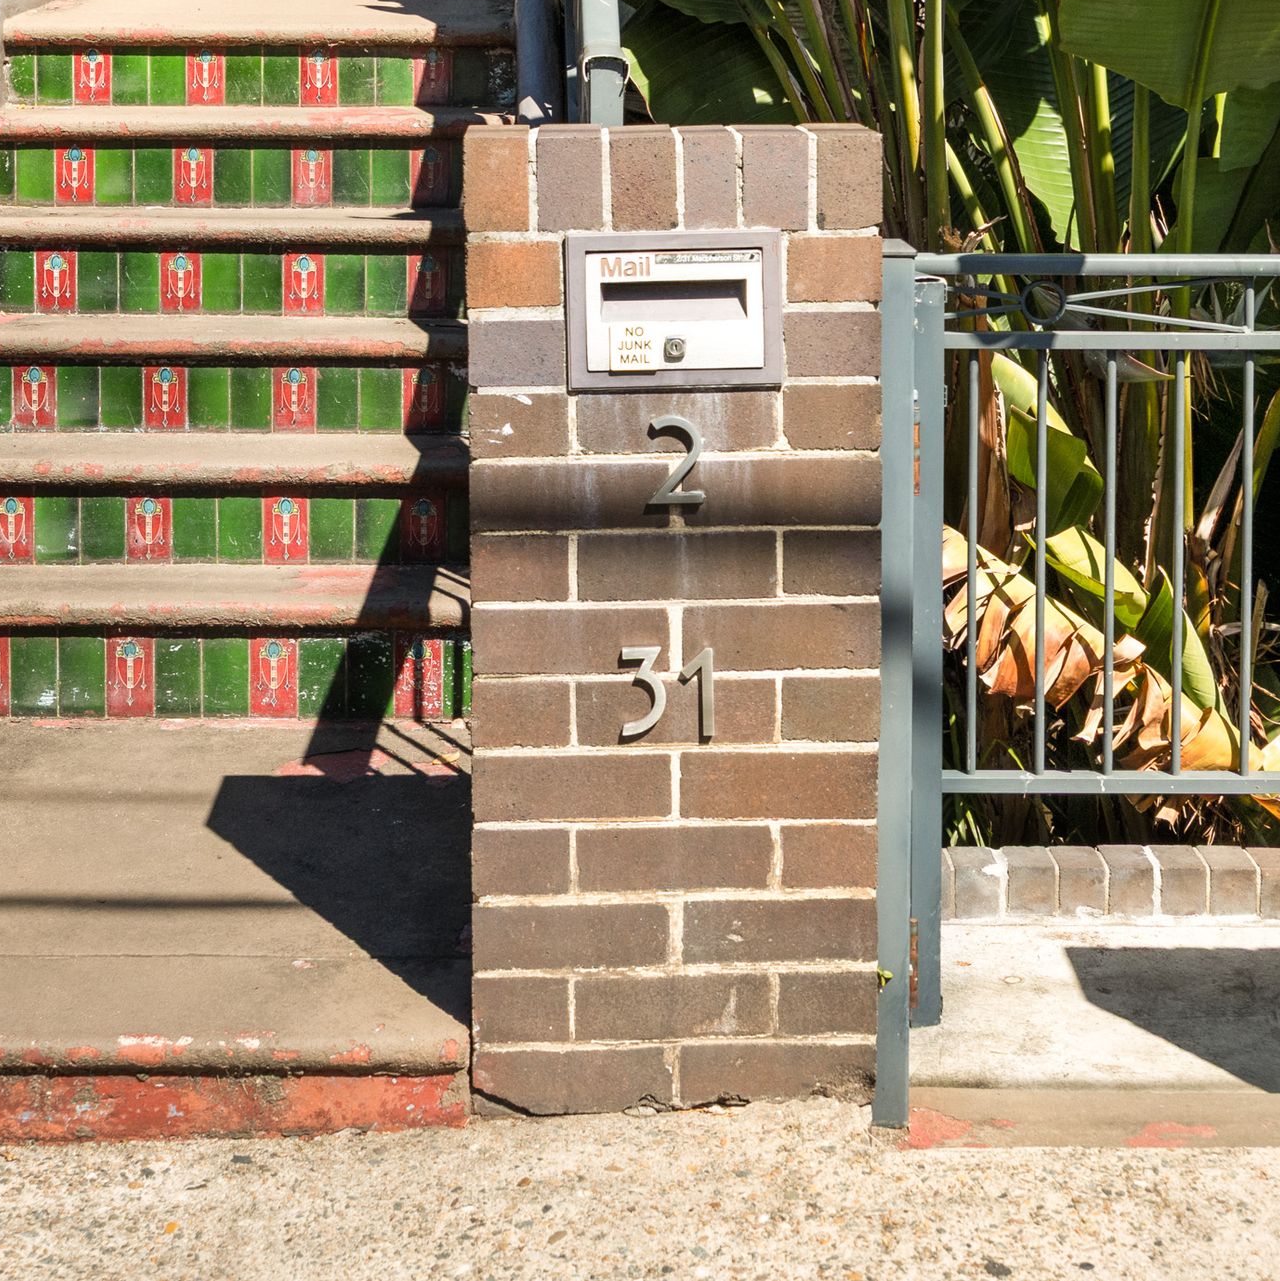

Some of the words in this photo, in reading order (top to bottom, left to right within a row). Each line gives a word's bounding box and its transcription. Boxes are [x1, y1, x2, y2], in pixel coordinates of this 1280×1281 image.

[600, 256, 651, 277] Mail
[625, 326, 644, 337] NO
[617, 340, 652, 351] JUNK
[620, 354, 650, 364] MAIL
[648, 414, 706, 505] 2
[620, 646, 715, 737] 31
